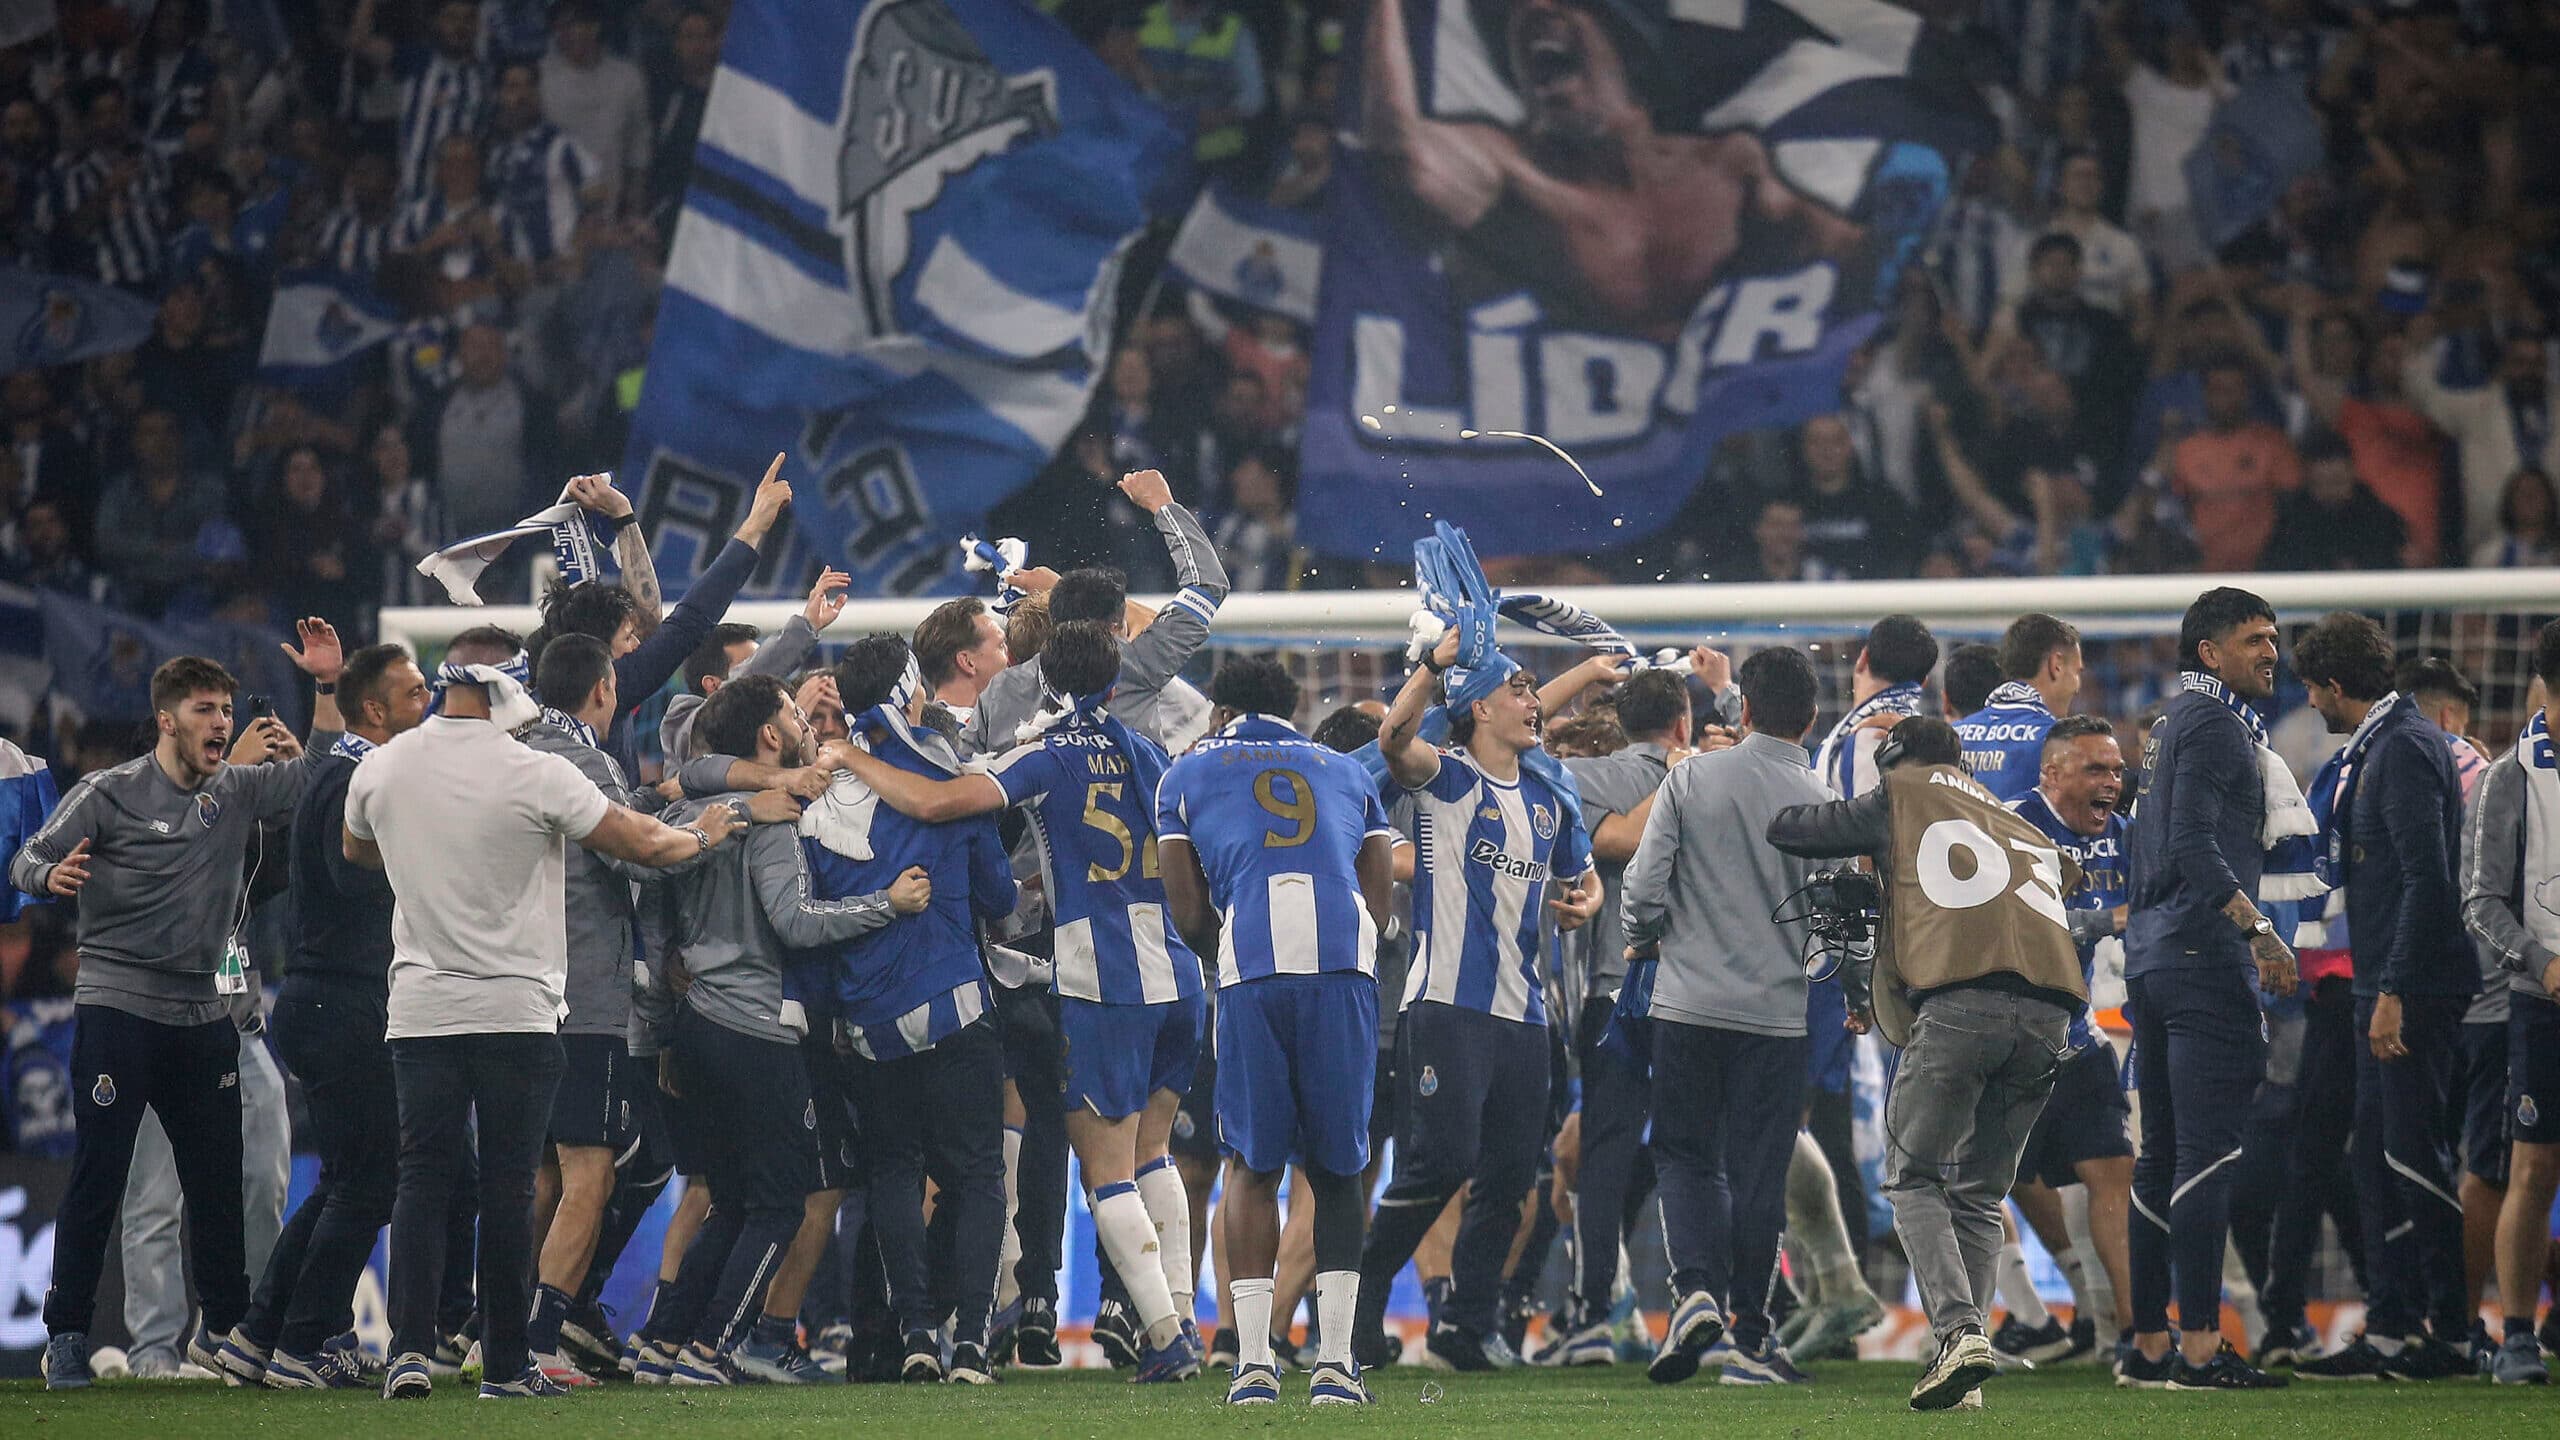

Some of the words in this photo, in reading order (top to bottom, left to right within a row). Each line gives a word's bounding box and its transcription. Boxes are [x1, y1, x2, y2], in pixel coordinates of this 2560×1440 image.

[1985, 724, 2041, 741] BOCK
[1253, 769, 1317, 848] 9
[1471, 838, 1545, 882] Betano
